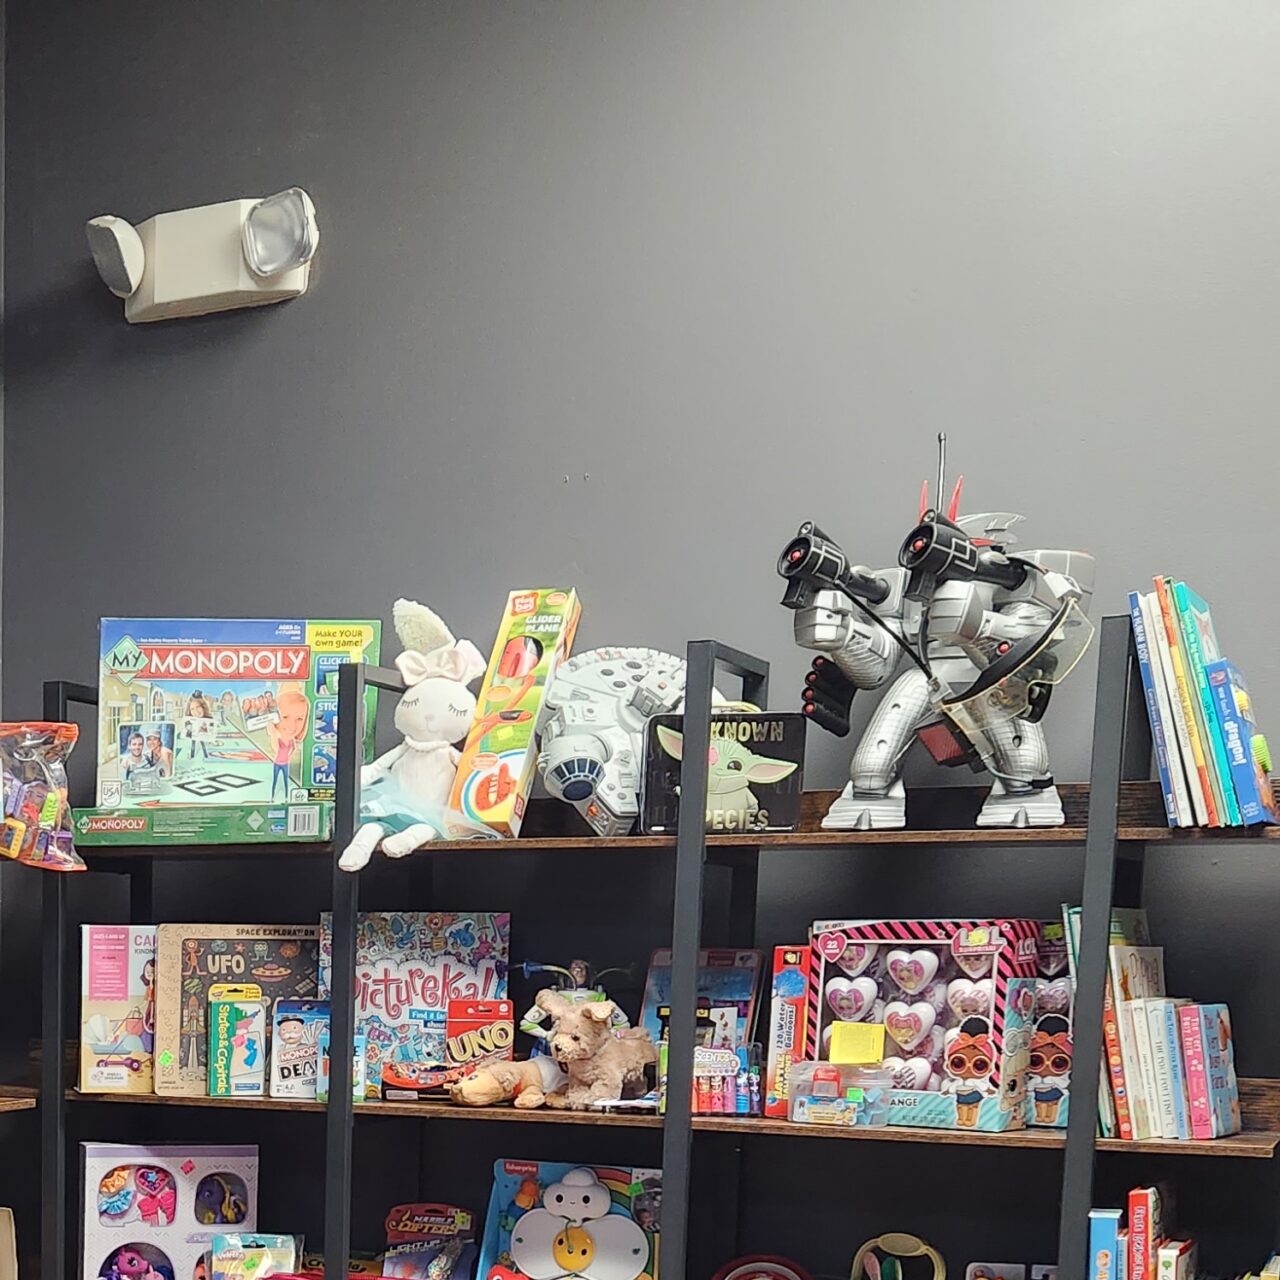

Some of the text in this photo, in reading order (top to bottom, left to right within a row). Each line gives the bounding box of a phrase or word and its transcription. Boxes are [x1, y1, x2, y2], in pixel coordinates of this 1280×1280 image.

[526, 615, 561, 623] GLIDER
[315, 630, 363, 638] Make YOUR
[335, 638, 363, 648] game!
[112, 650, 305, 674] MY MONOPOLY
[319, 656, 344, 666] CLICK
[172, 773, 265, 797] GO
[103, 786, 119, 798] USA
[91, 818, 145, 830] MONOPOLY
[235, 928, 261, 936] SPACE
[827, 941, 838, 949] 22
[207, 955, 245, 974] UFO
[777, 1002, 786, 1032] Water
[784, 1005, 795, 1049] Balloons!
[448, 1021, 515, 1063] UNO
[214, 1004, 229, 1094] States & Capitals
[413, 1216, 453, 1224] MARBLE
[398, 1222, 458, 1234] COPTERS
[390, 1239, 440, 1253] LIGHT UP
